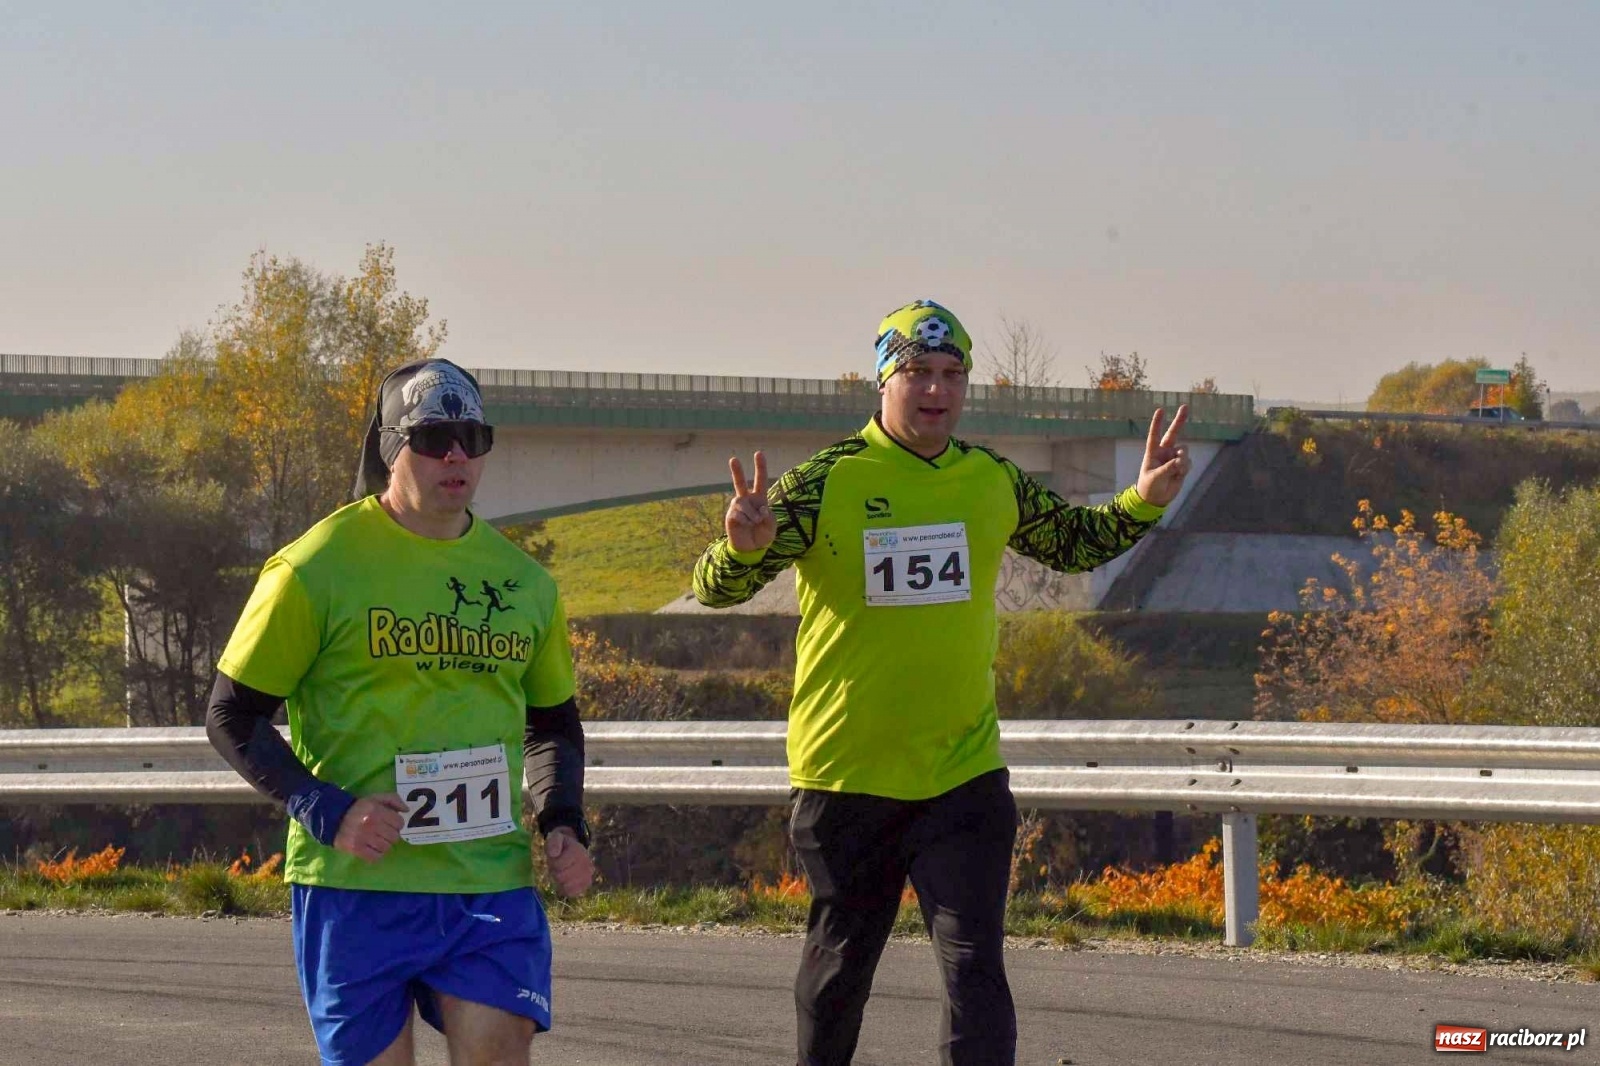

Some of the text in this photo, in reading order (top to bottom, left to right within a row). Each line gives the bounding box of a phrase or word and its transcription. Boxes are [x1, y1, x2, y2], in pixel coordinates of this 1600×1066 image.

[873, 551, 964, 591] 154
[368, 607, 531, 662] Radlinioki
[416, 657, 499, 673] w biegu
[443, 756, 503, 770] www.personalbest.pl
[406, 778, 499, 828] 211
